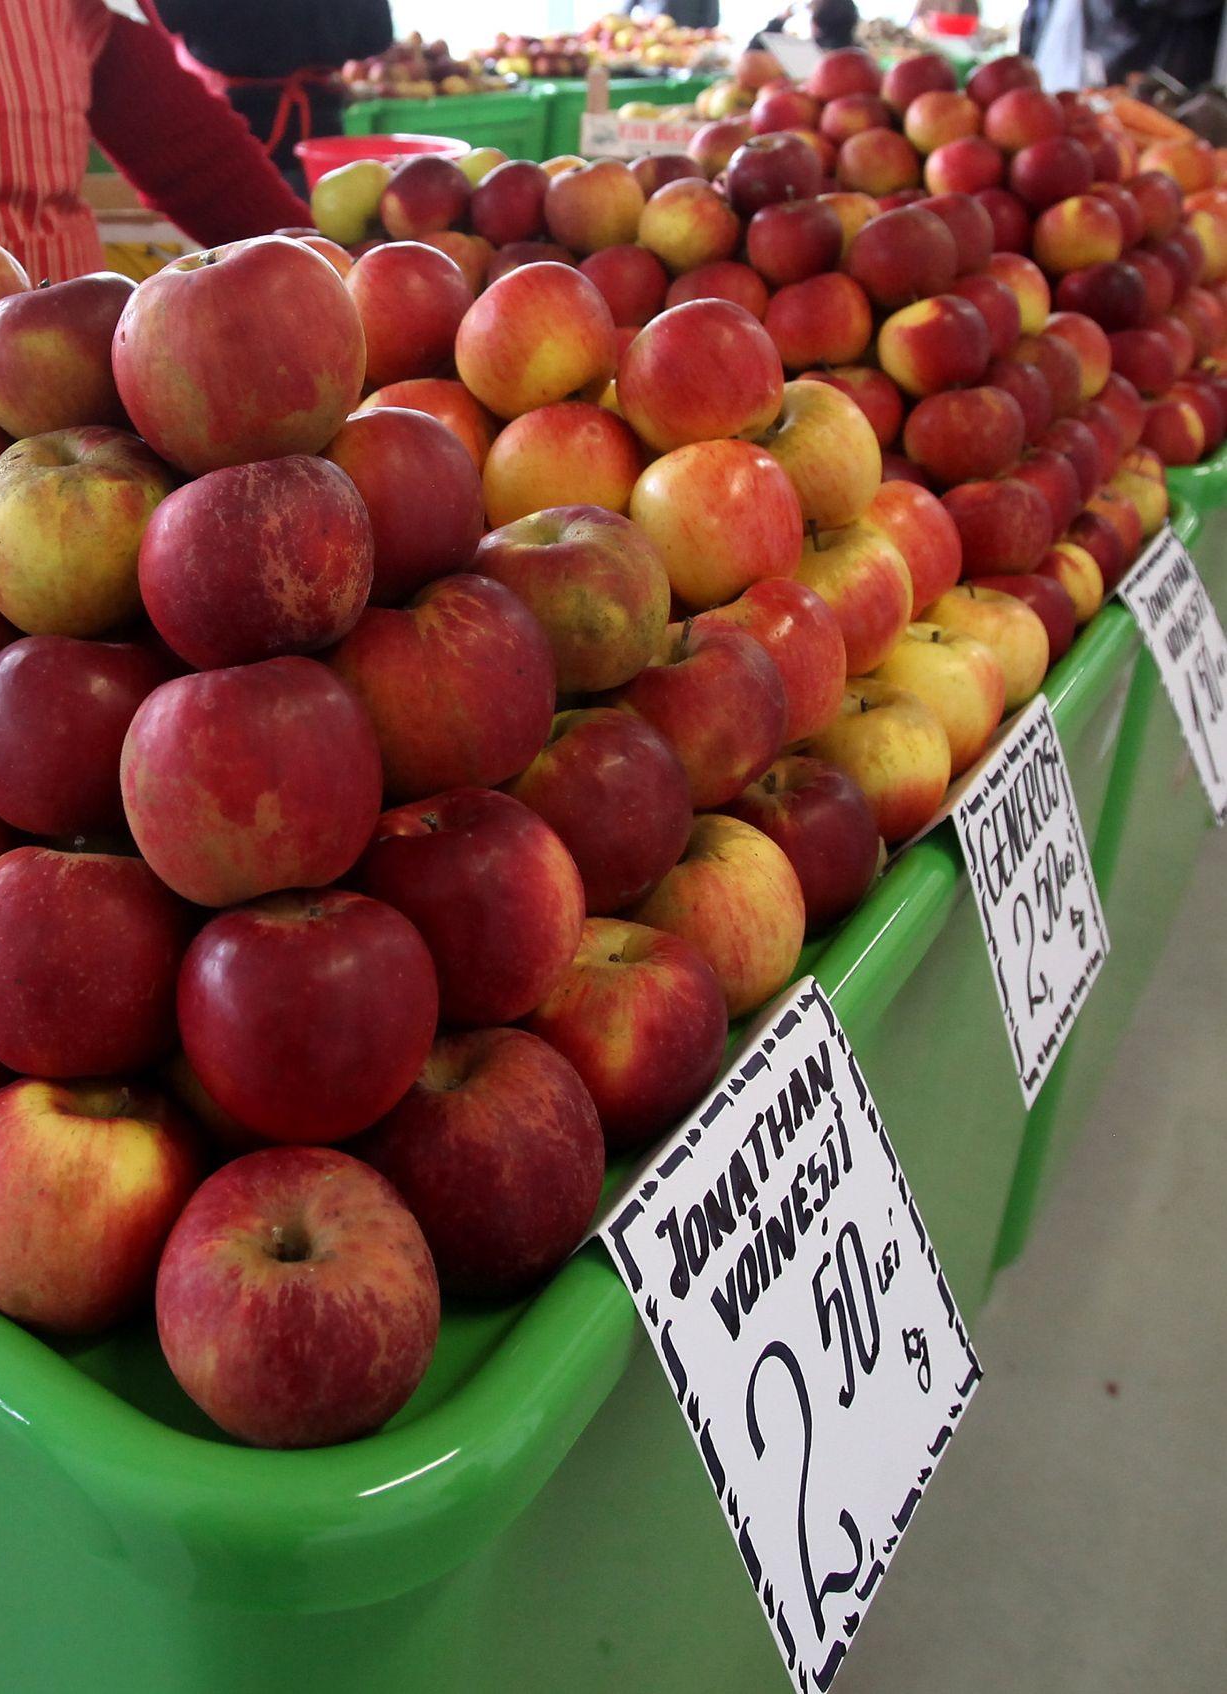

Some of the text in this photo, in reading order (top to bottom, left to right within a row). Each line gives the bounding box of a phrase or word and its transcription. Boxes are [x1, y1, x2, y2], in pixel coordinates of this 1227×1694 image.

[1034, 841, 1063, 944] 50
[655, 1040, 835, 1300] JONATHAN
[811, 1221, 881, 1409] 50
